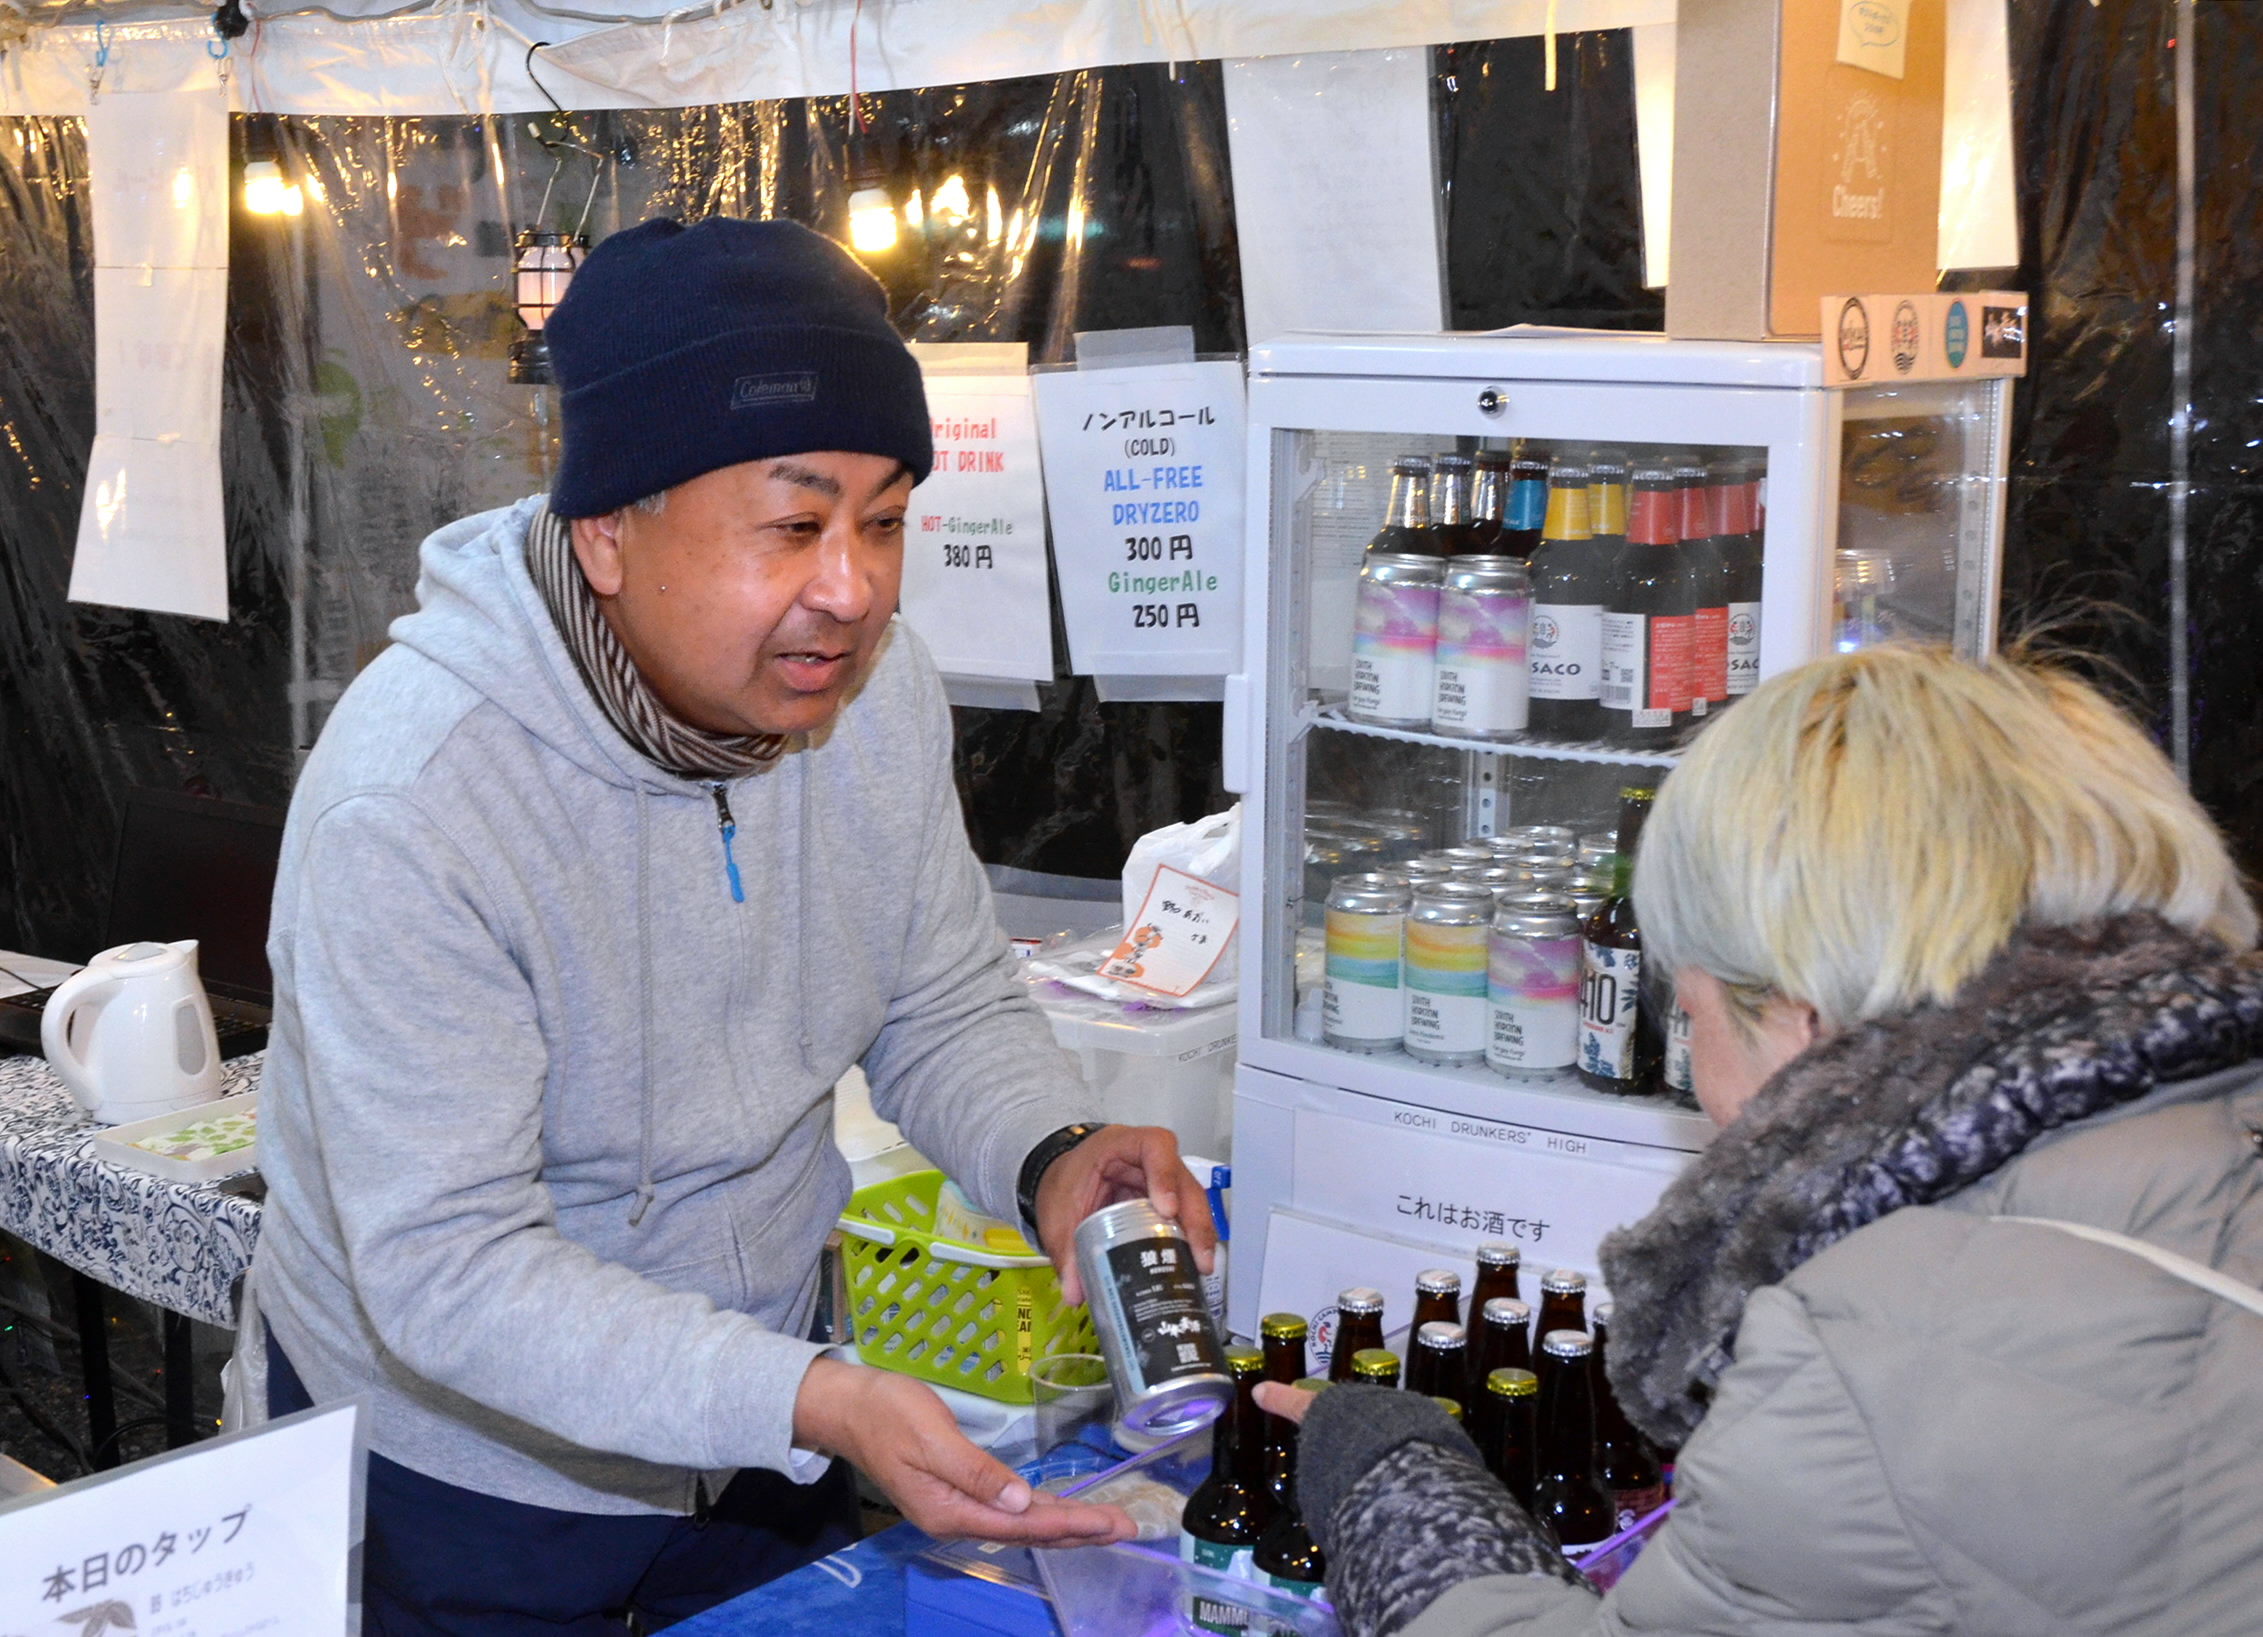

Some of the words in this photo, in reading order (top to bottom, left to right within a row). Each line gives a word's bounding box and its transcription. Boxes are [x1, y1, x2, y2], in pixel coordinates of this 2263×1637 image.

[1832, 184, 1885, 219] Cheers!
[739, 379, 798, 398] Coleman
[1082, 406, 1216, 432] ノンアルコール
[1124, 437, 1176, 459] (COLD)
[932, 450, 949, 472] OT
[957, 450, 1005, 473] DRINK
[1103, 465, 1204, 492] ALL-FREE
[920, 515, 1014, 536] HOT-GingerAle
[1112, 500, 1200, 526] DRYZERO
[943, 544, 970, 568] 380
[975, 544, 993, 569] 円
[1125, 536, 1162, 562] 300
[1169, 534, 1193, 561] 円
[1107, 569, 1219, 595] GingerAle
[1132, 603, 1169, 628] 250
[1176, 603, 1200, 628] 円
[1531, 661, 1582, 676] SACO
[1207, 1032, 1239, 1053] DRUNKE
[1394, 1111, 1437, 1130] KOCHI
[1450, 1120, 1532, 1144] DRUNKERS'
[1547, 1136, 1587, 1155] HIGH
[1396, 1194, 1551, 1243] これはお酒です
[41, 1502, 253, 1604] 本日のタップ
